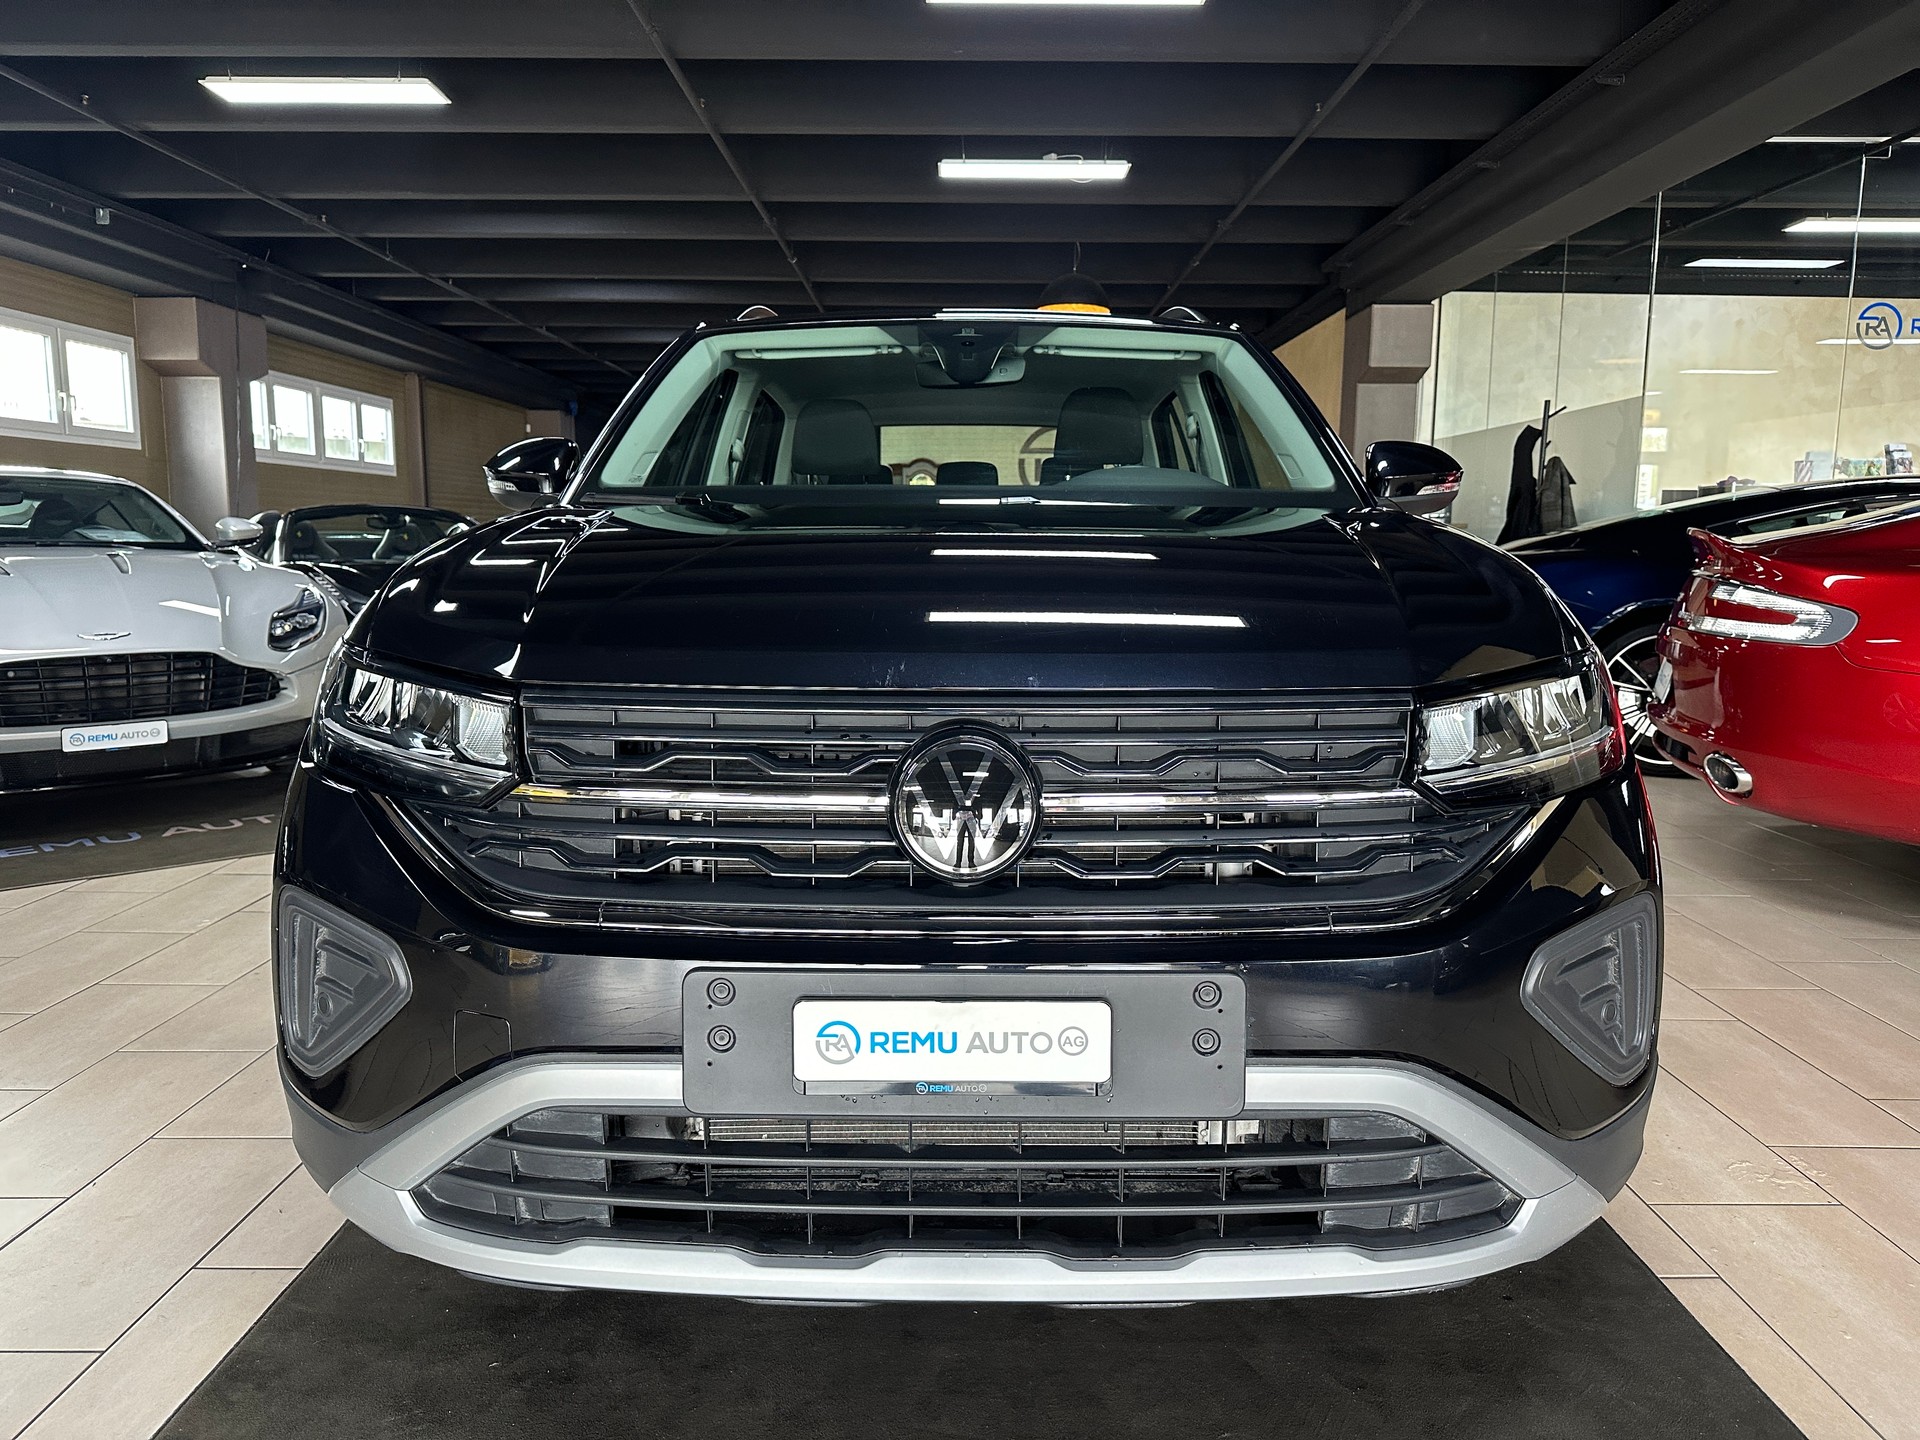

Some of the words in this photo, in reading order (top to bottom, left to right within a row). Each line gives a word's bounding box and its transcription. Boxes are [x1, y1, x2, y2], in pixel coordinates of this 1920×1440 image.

[87, 733, 118, 743] REMU
[120, 730, 149, 740] AUTO
[904, 746, 1030, 864] VW
[870, 1031, 957, 1054] REMU
[965, 1031, 1053, 1055] AUTO
[1063, 1035, 1085, 1048] AG
[929, 1084, 954, 1093] REMU
[954, 1085, 978, 1093] AUTO
